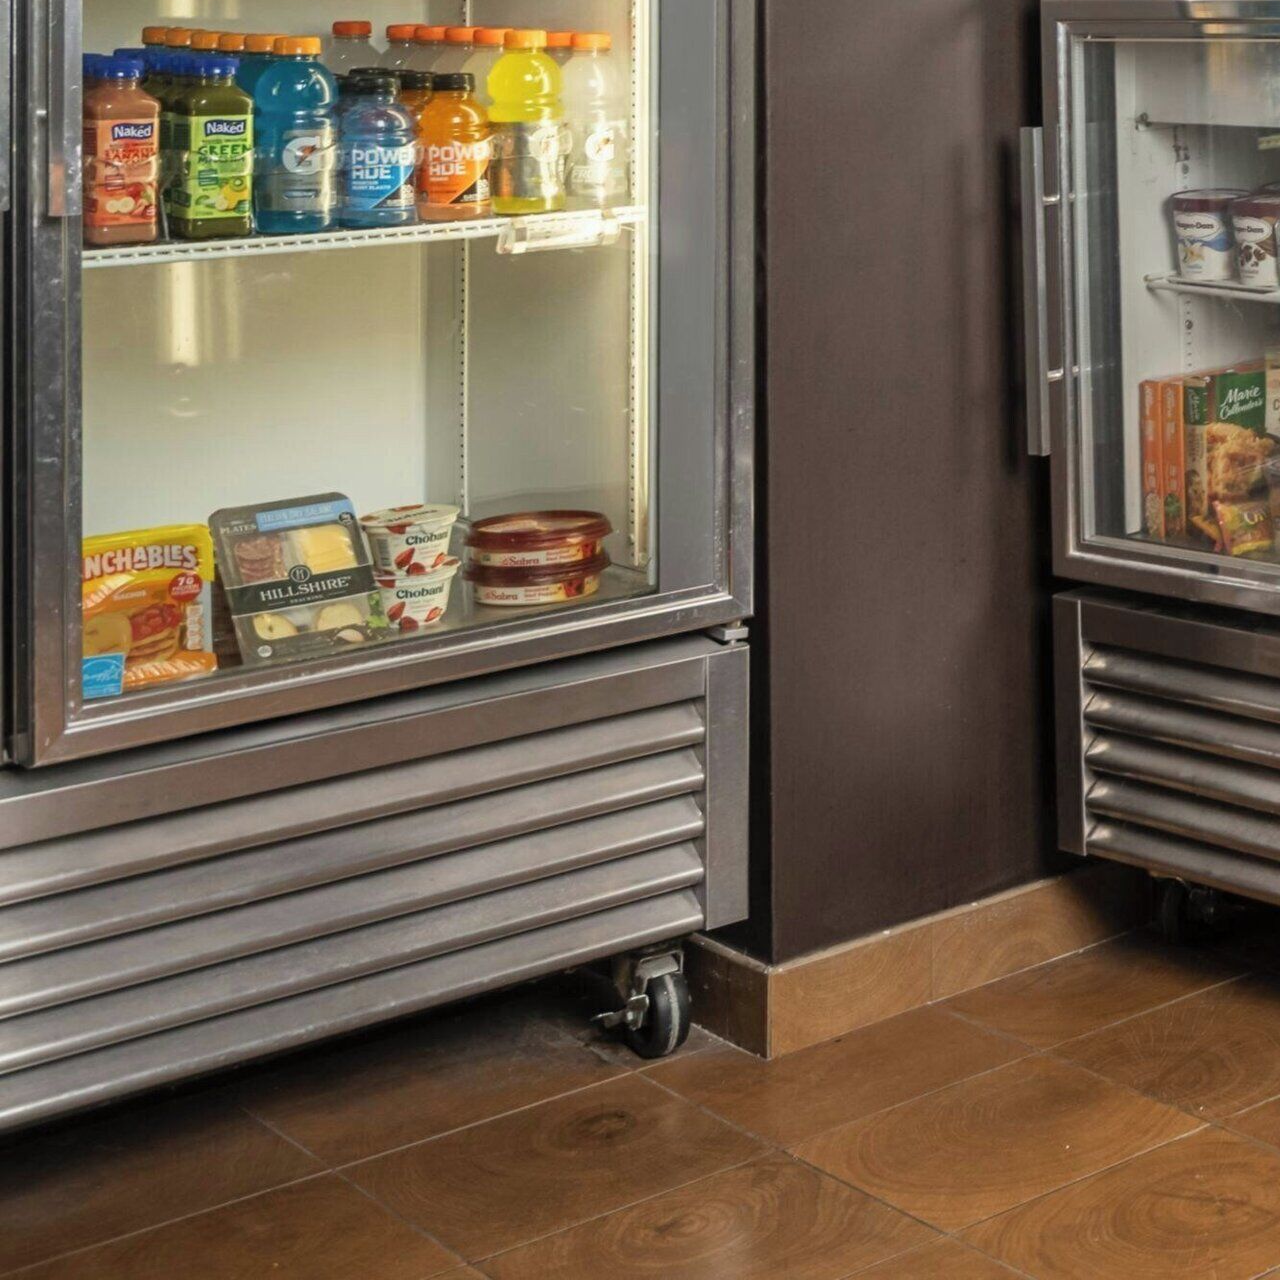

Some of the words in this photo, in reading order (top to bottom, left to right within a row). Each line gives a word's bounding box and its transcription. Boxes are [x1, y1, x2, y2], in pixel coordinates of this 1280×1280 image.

[198, 144, 252, 156] GREEN
[509, 557, 539, 565] Sabra
[260, 578, 349, 602] HILLSHIRE
[396, 584, 444, 599] Chobani
[490, 591, 518, 601] Sabra
